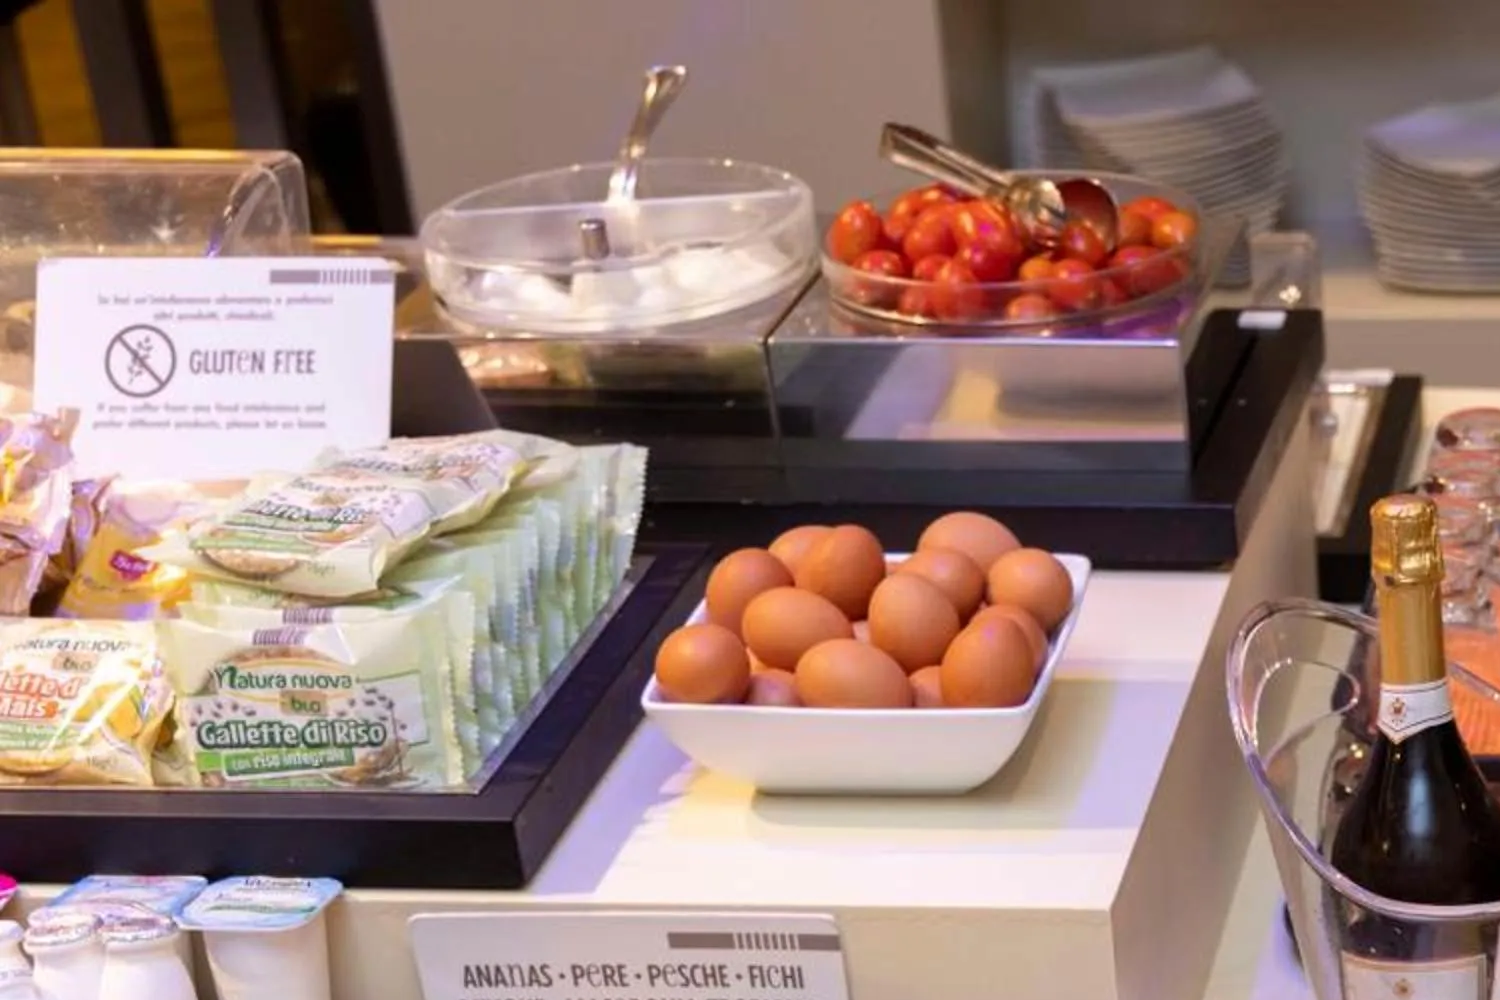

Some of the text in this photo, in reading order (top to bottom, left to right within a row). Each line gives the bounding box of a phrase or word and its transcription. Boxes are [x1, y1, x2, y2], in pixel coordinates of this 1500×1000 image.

[0, 670, 58, 696] lette
[292, 673, 352, 690] nuova
[199, 719, 387, 748] Gallette di Riso
